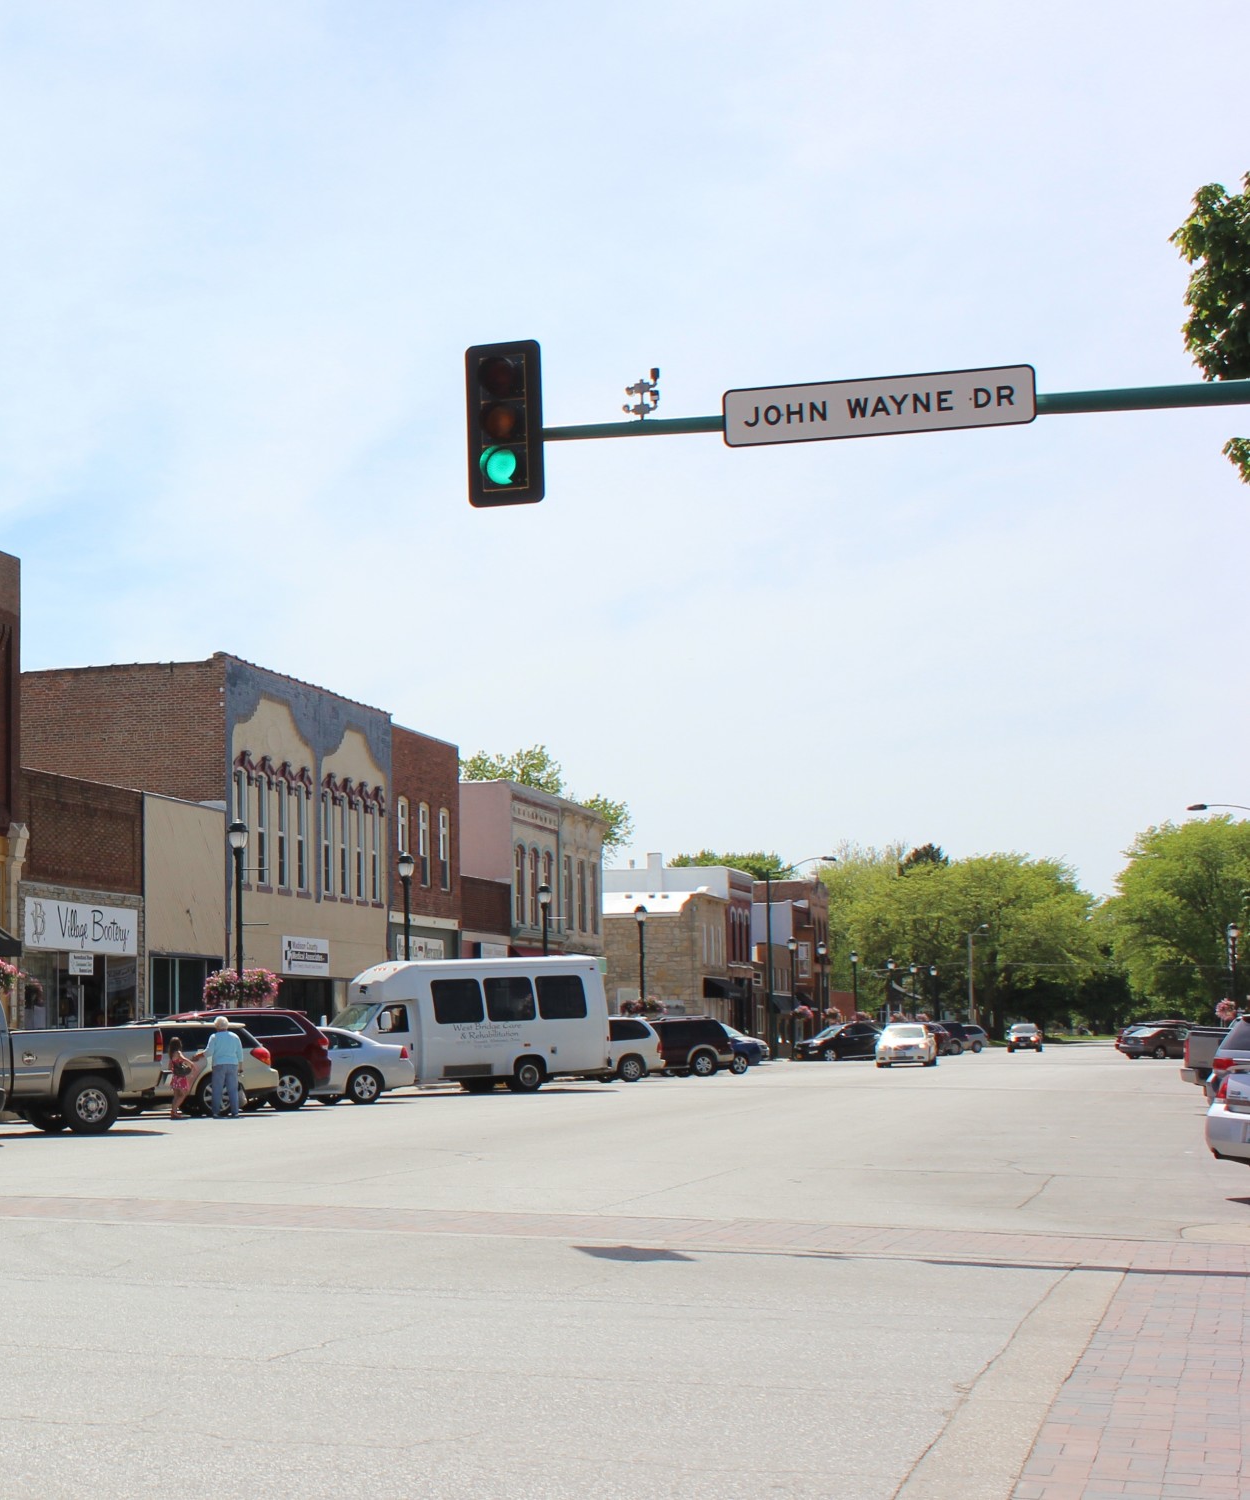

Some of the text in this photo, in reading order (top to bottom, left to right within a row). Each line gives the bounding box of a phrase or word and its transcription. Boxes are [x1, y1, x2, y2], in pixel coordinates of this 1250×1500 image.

[744, 384, 1015, 428] JOHN WAYNE DR
[57, 905, 130, 952] Village Bootery
[453, 1021, 522, 1032] West Bridge Care
[469, 1031, 519, 1039] Rehabilitation
